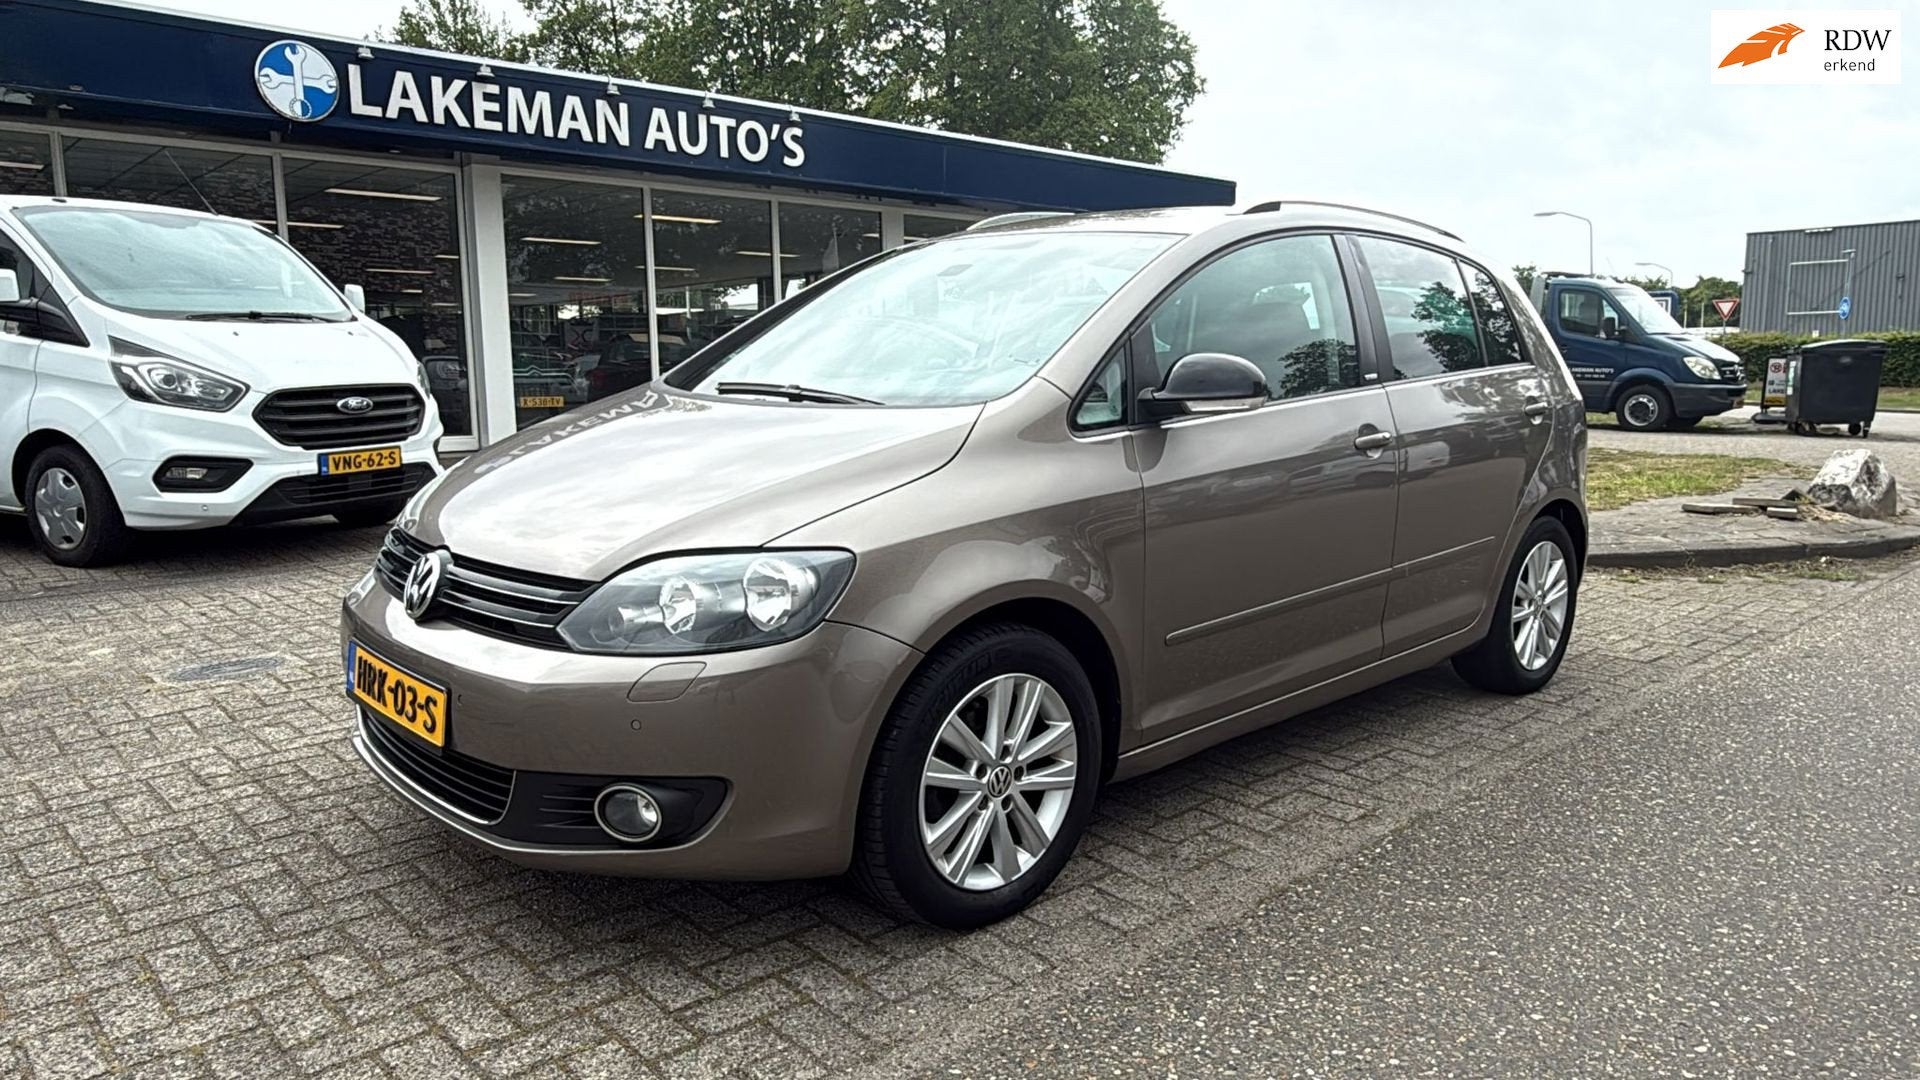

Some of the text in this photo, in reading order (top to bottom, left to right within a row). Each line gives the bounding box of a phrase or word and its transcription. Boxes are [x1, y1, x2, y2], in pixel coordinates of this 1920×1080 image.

[347, 62, 807, 168] LAKEMAN AUTO'S
[332, 451, 397, 471] VNG-62-S
[356, 655, 438, 735] HRK-03-S
